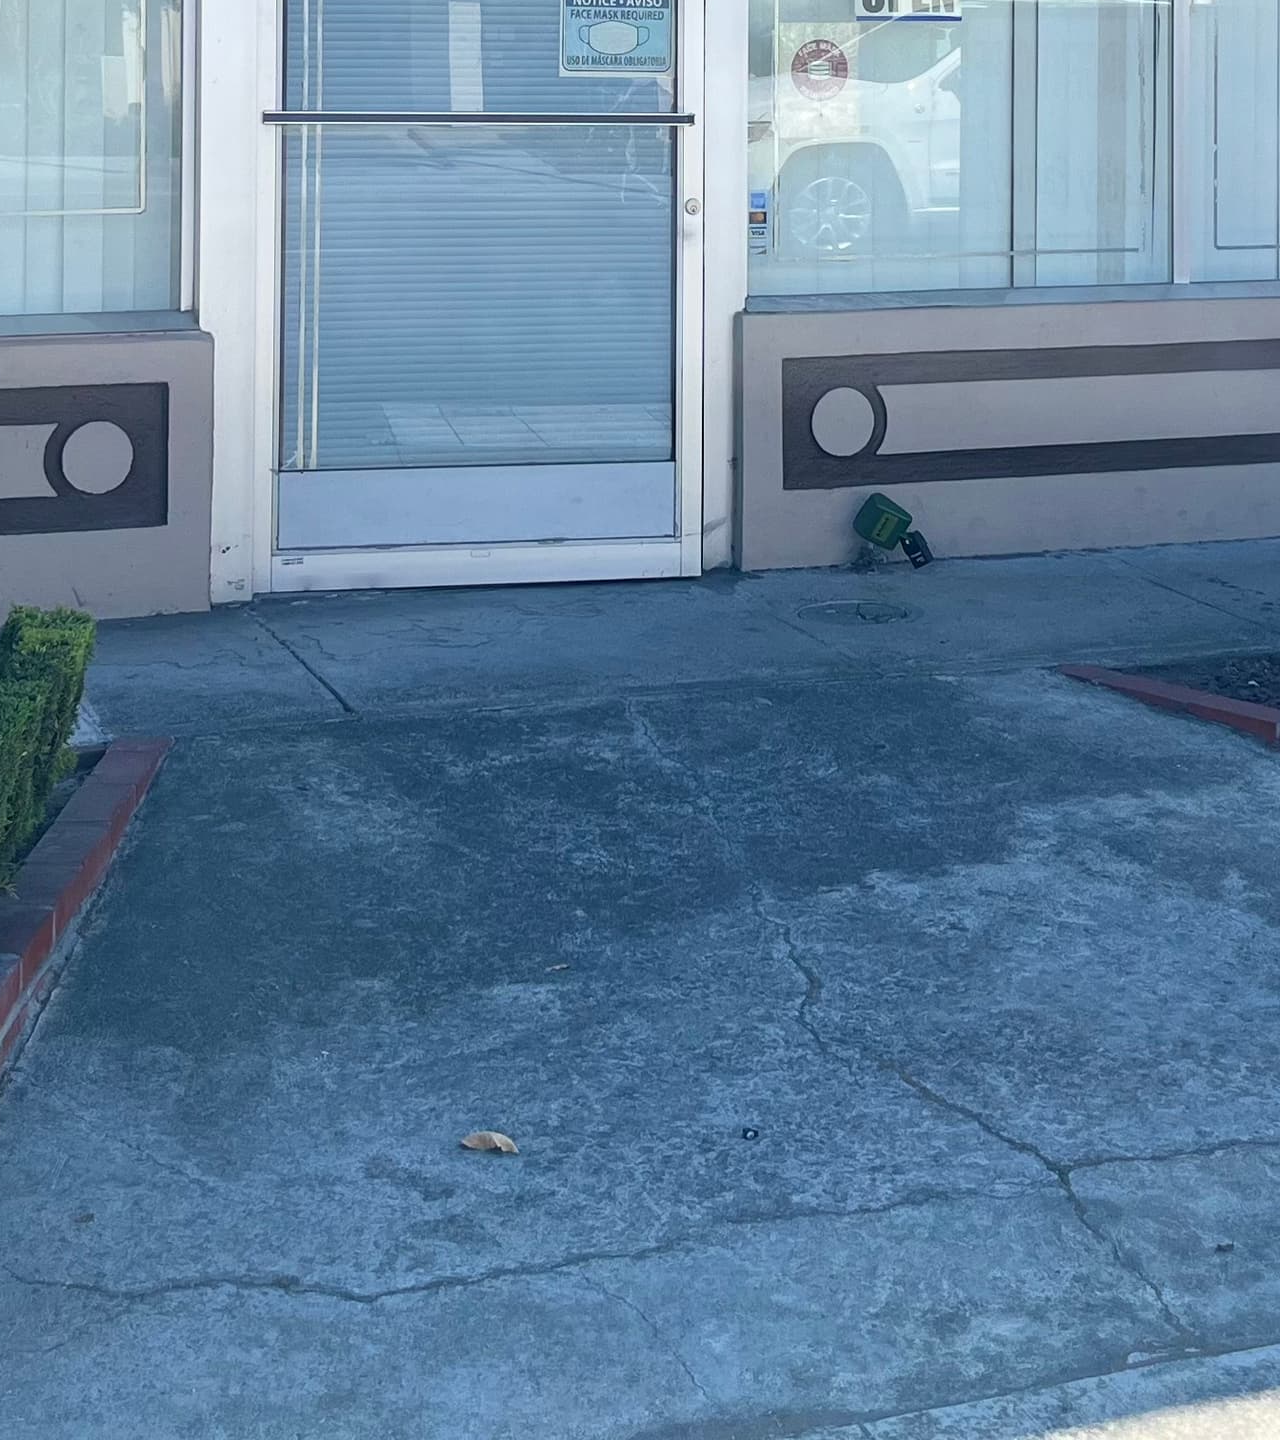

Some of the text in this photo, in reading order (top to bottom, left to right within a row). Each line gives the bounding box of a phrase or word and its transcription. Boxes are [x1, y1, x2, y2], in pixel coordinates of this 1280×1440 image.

[570, 9, 664, 21] FACE MASK REQUIRED
[566, 56, 580, 65] USO
[581, 56, 589, 65] DE
[624, 56, 666, 66] OBLIGATORIA
